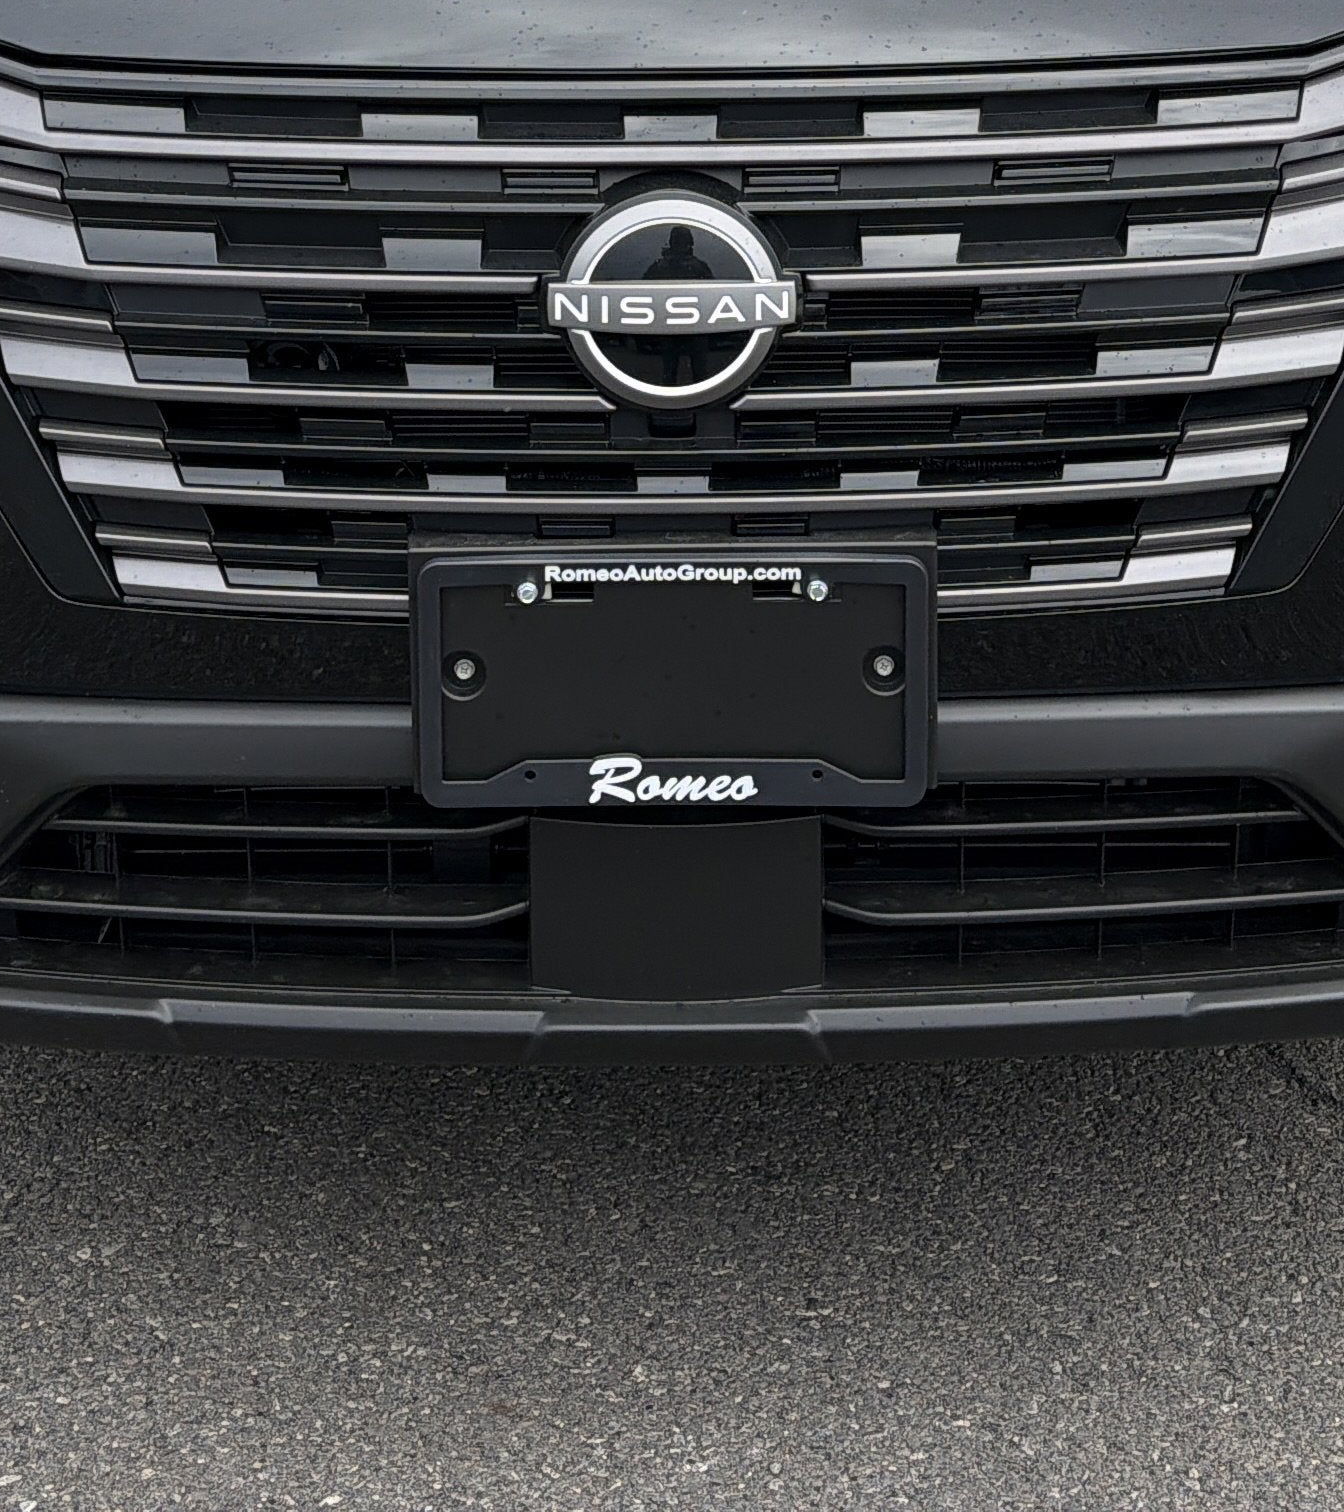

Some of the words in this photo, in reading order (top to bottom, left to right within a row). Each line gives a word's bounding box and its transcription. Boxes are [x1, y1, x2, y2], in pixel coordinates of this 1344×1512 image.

[554, 290, 789, 325] NISSAN
[544, 564, 802, 584] RomeoAutoGroup.com
[588, 756, 759, 804] Romeo
